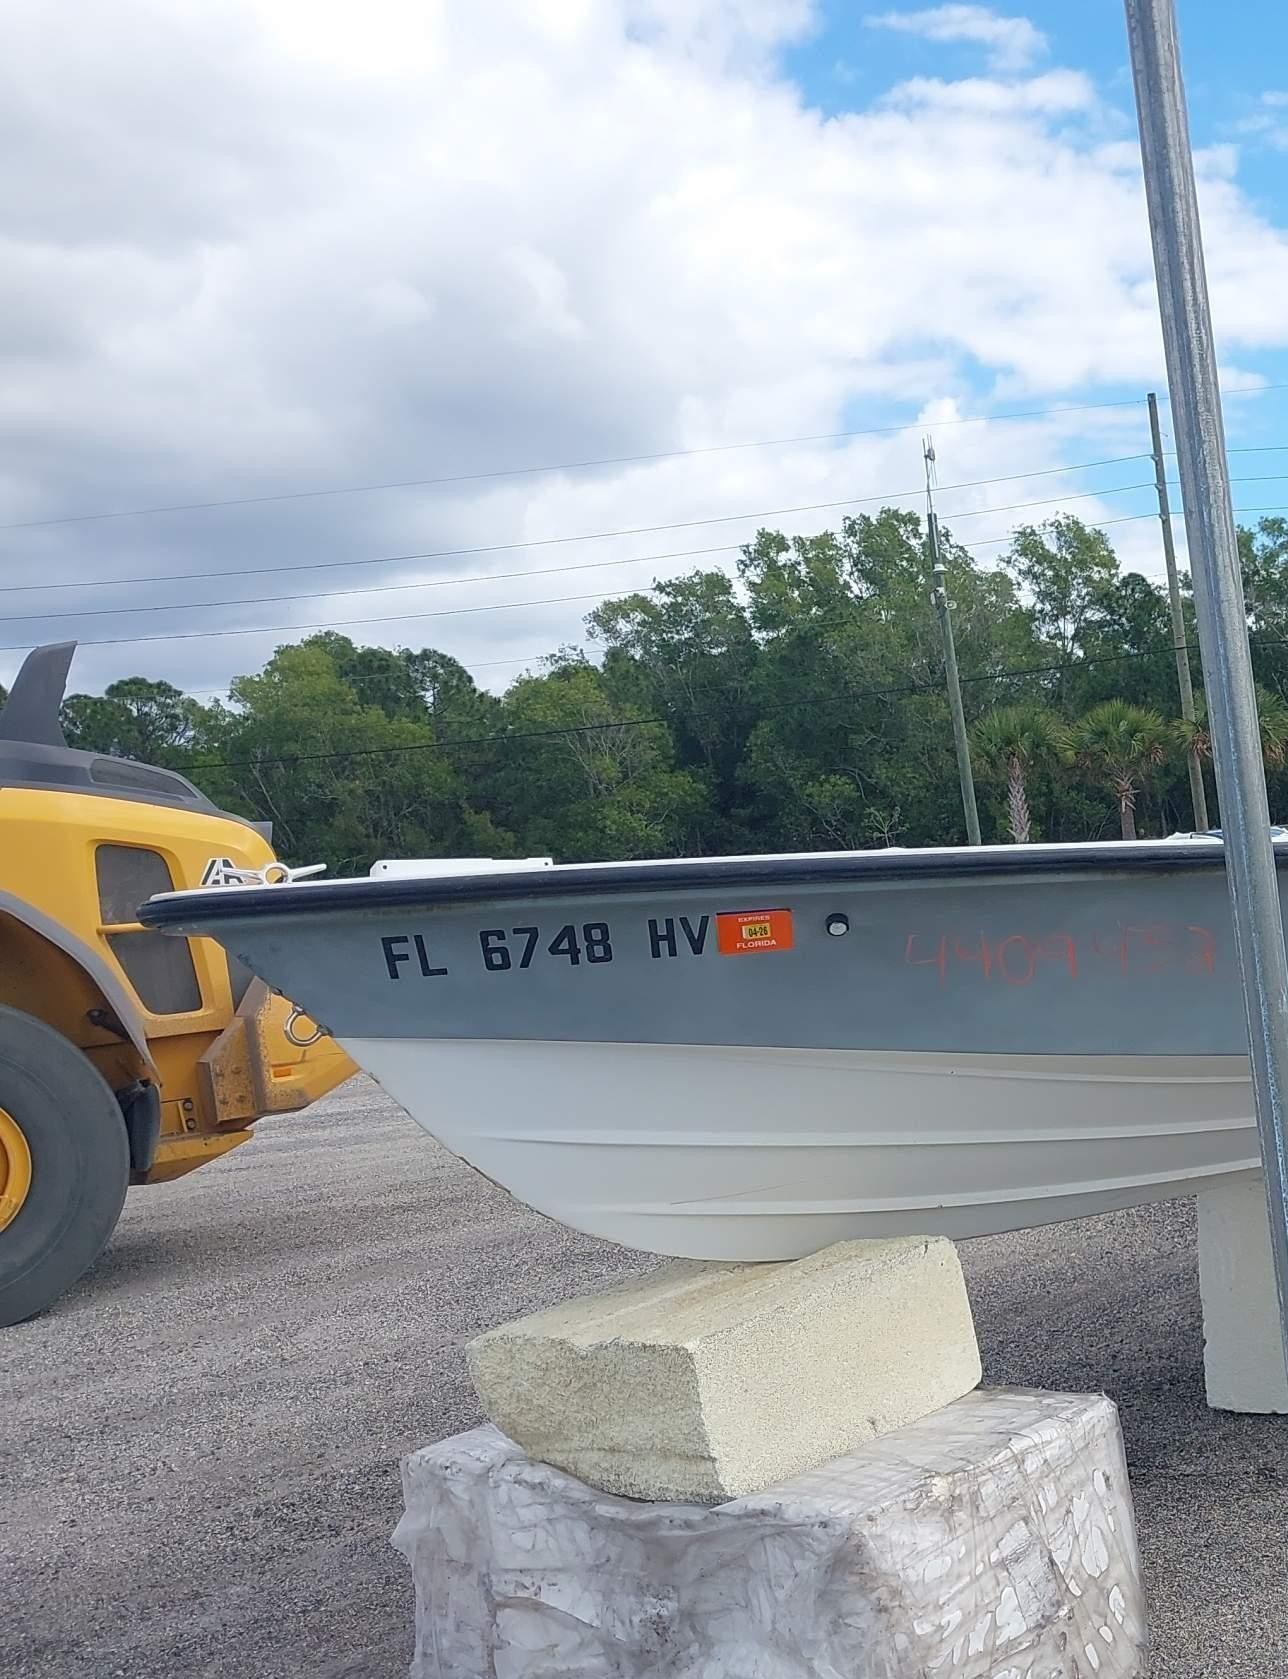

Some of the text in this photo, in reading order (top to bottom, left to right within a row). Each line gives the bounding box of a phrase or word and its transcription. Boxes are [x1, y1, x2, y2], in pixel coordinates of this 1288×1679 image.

[748, 926, 768, 937] 04-26
[381, 915, 709, 979] FL 6748 HV
[736, 939, 777, 949] FLORIDA
